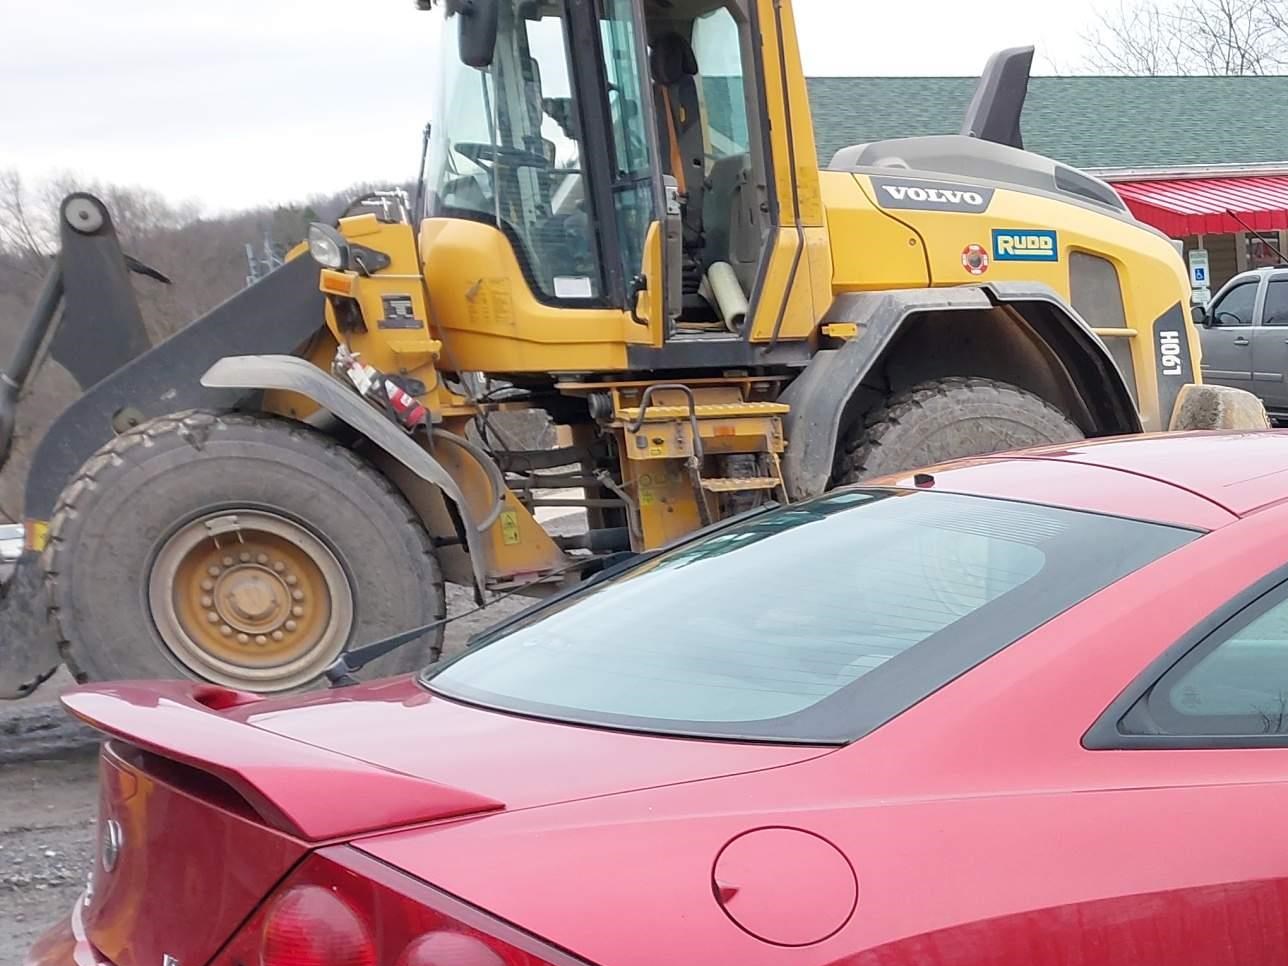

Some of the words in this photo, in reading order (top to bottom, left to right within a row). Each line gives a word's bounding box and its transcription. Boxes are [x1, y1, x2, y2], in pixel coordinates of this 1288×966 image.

[882, 185, 984, 205] VOLVO
[997, 235, 1053, 255] RUDD
[1160, 331, 1182, 375] L90H
